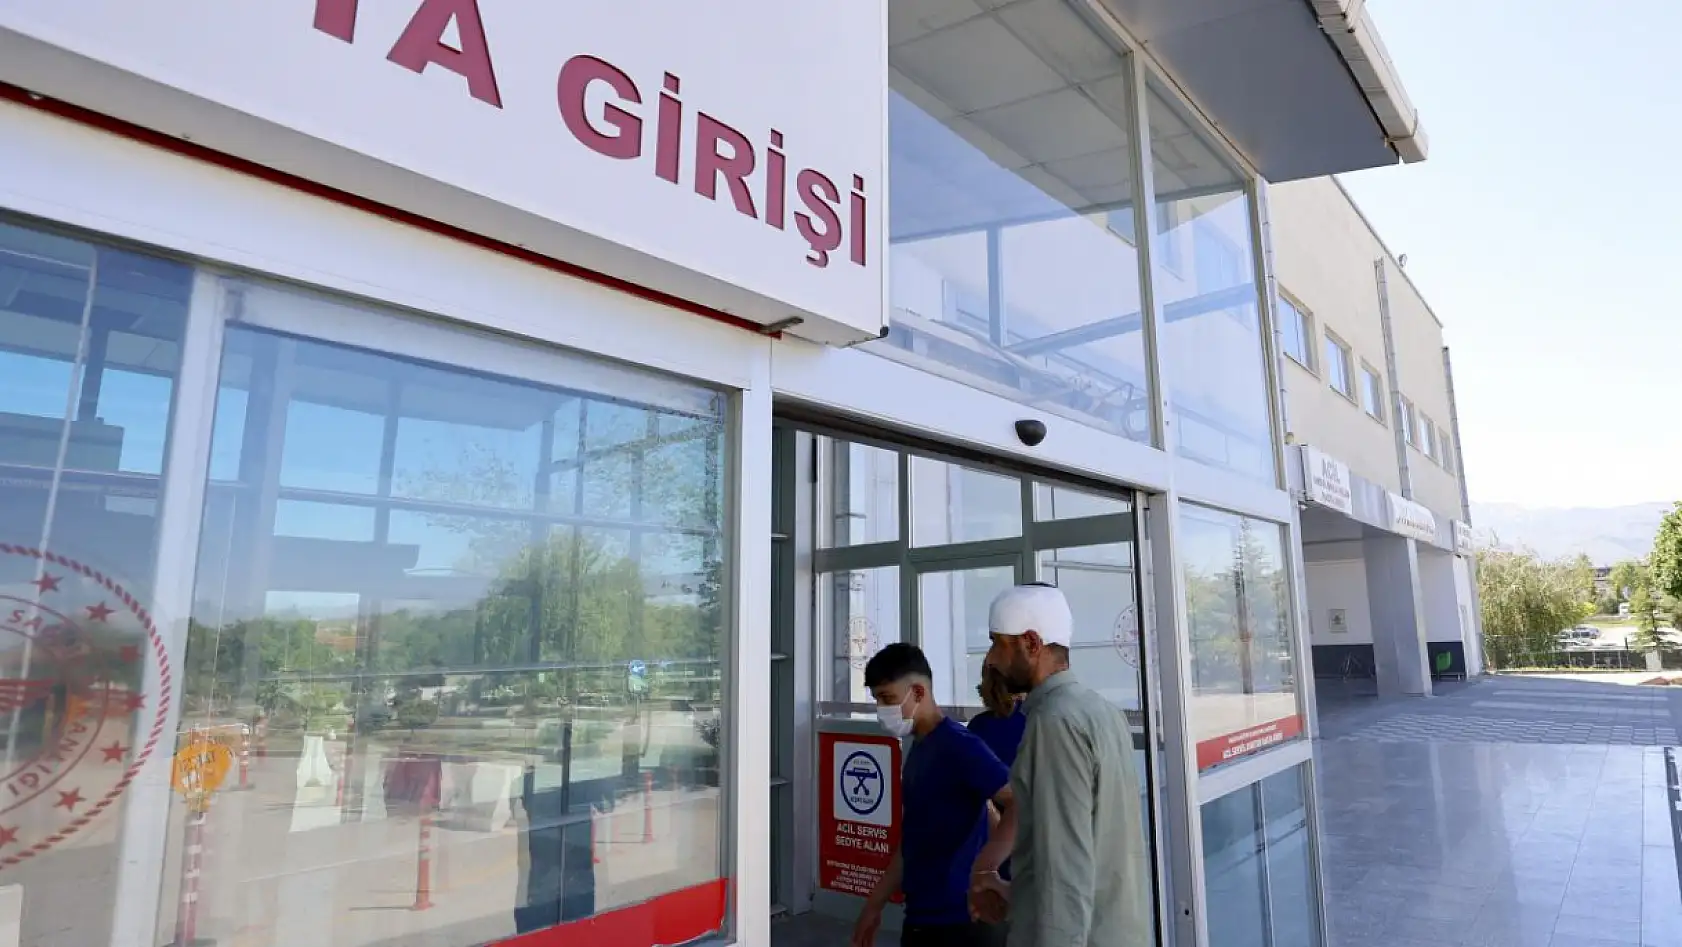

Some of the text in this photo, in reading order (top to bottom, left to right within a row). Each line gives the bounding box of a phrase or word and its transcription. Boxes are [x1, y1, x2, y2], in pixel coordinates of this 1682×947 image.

[557, 55, 866, 268] GİRİŞİ
[837, 823, 888, 839] ACİL SERVİS
[835, 835, 889, 853] SEDYE ALANI
